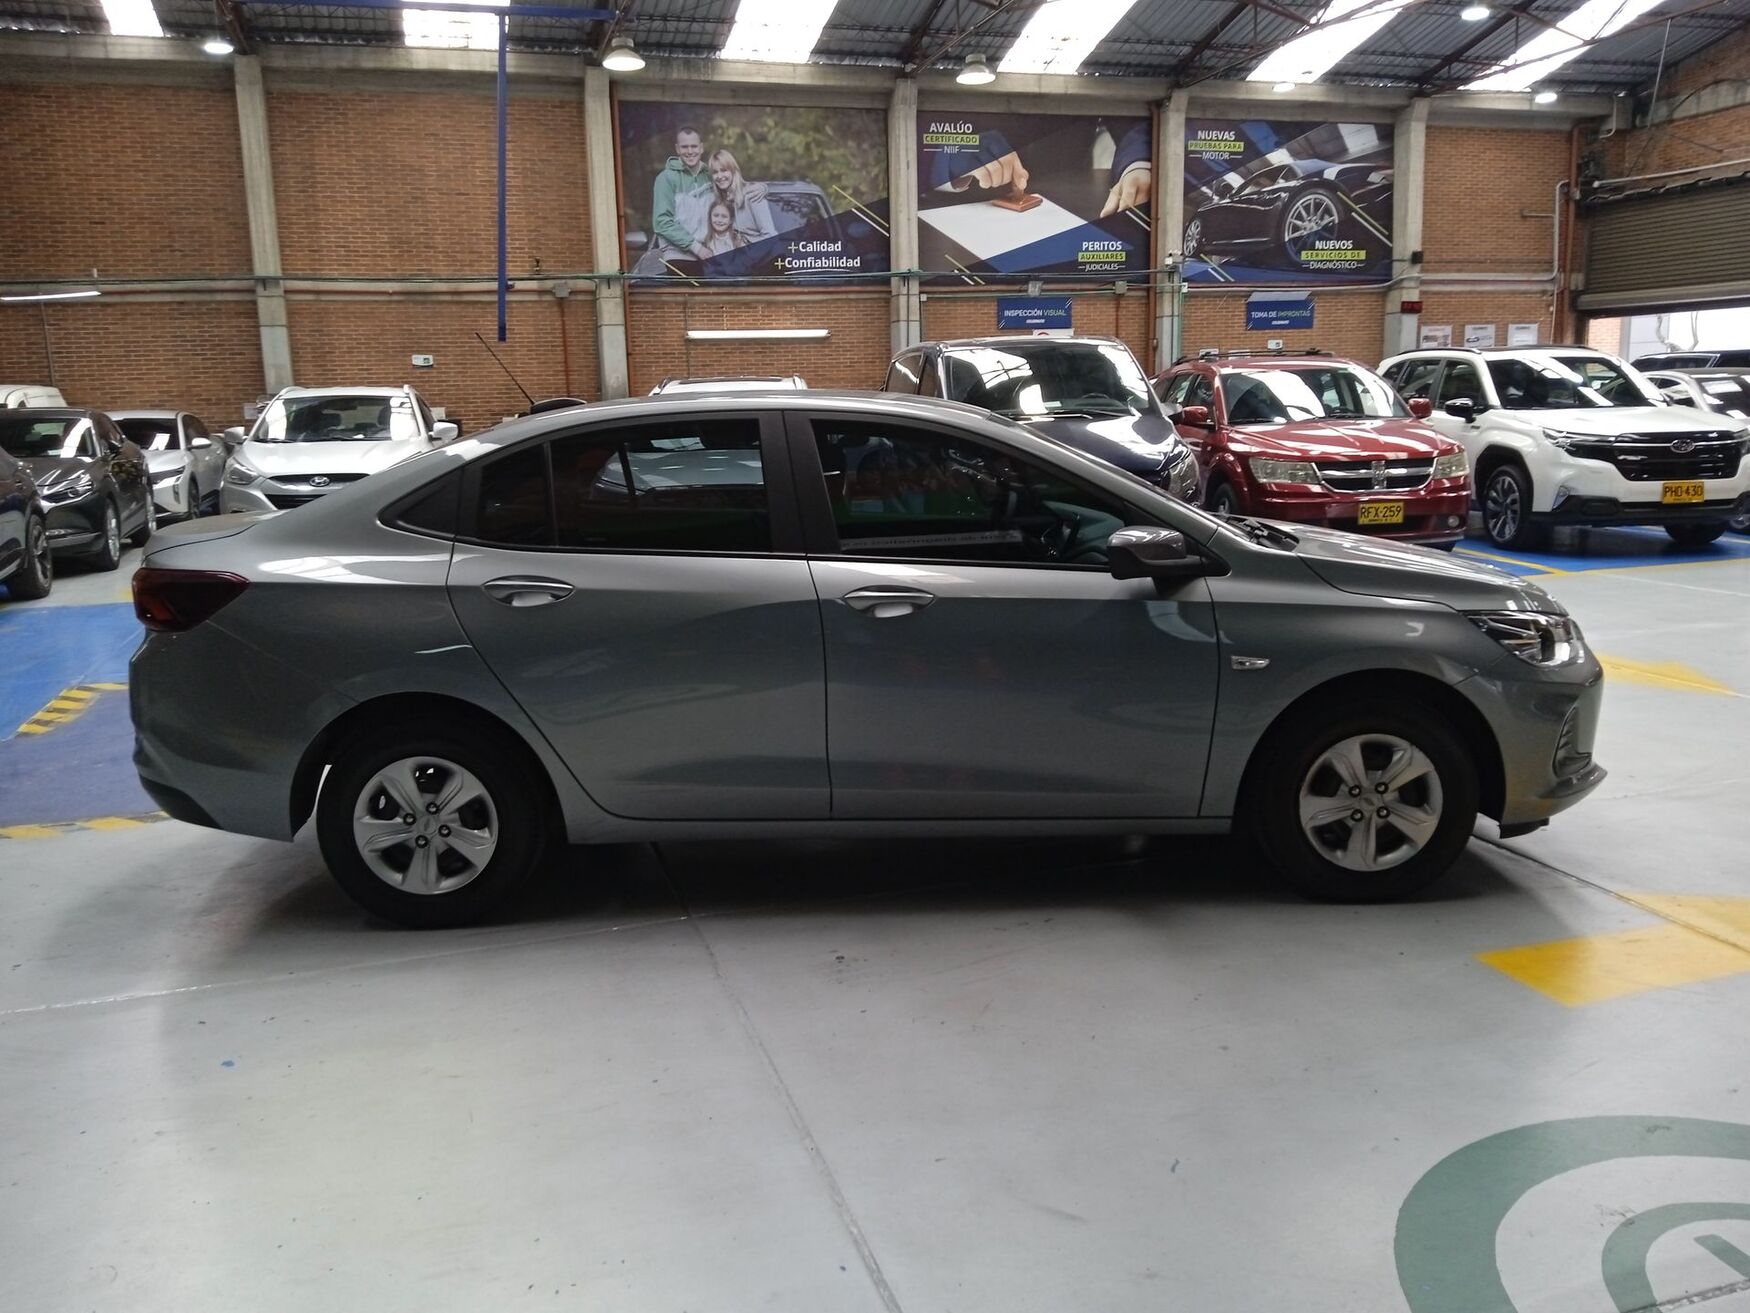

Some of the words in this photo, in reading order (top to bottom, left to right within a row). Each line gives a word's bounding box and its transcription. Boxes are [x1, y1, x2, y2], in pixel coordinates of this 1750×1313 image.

[930, 121, 973, 133] AVALÚO
[925, 135, 978, 144] CERTIFICADO
[1198, 130, 1236, 140] NUEVAS
[1202, 152, 1230, 160] MOTOR
[1082, 241, 1122, 250] PERITOS
[1315, 240, 1353, 250] NUEVOS
[1305, 251, 1348, 259] SERVICIOS
[1350, 251, 1361, 259] DE
[1004, 309, 1043, 317] INSPECCIÓN
[1044, 309, 1067, 317] VISUAL
